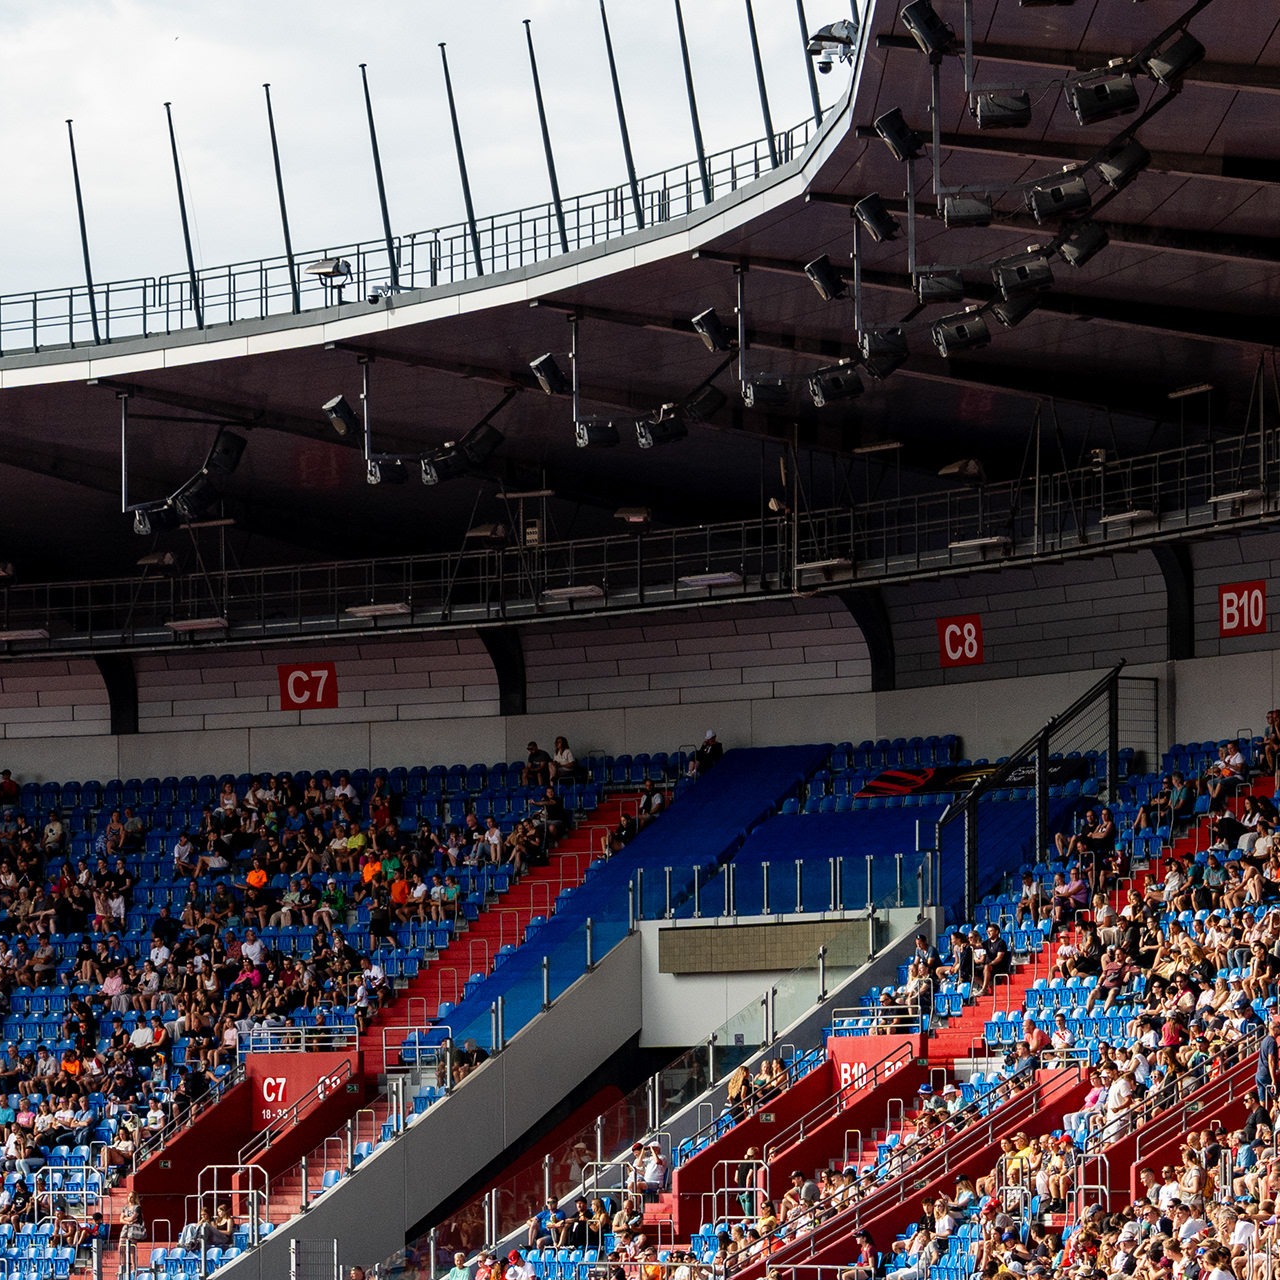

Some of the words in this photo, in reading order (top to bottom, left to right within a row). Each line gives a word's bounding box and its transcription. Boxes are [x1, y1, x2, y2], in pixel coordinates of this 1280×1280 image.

[1222, 589, 1264, 630] B10
[944, 622, 979, 661] C8
[287, 670, 329, 704] C7
[263, 1077, 287, 1102] C7
[840, 1062, 867, 1090] B10
